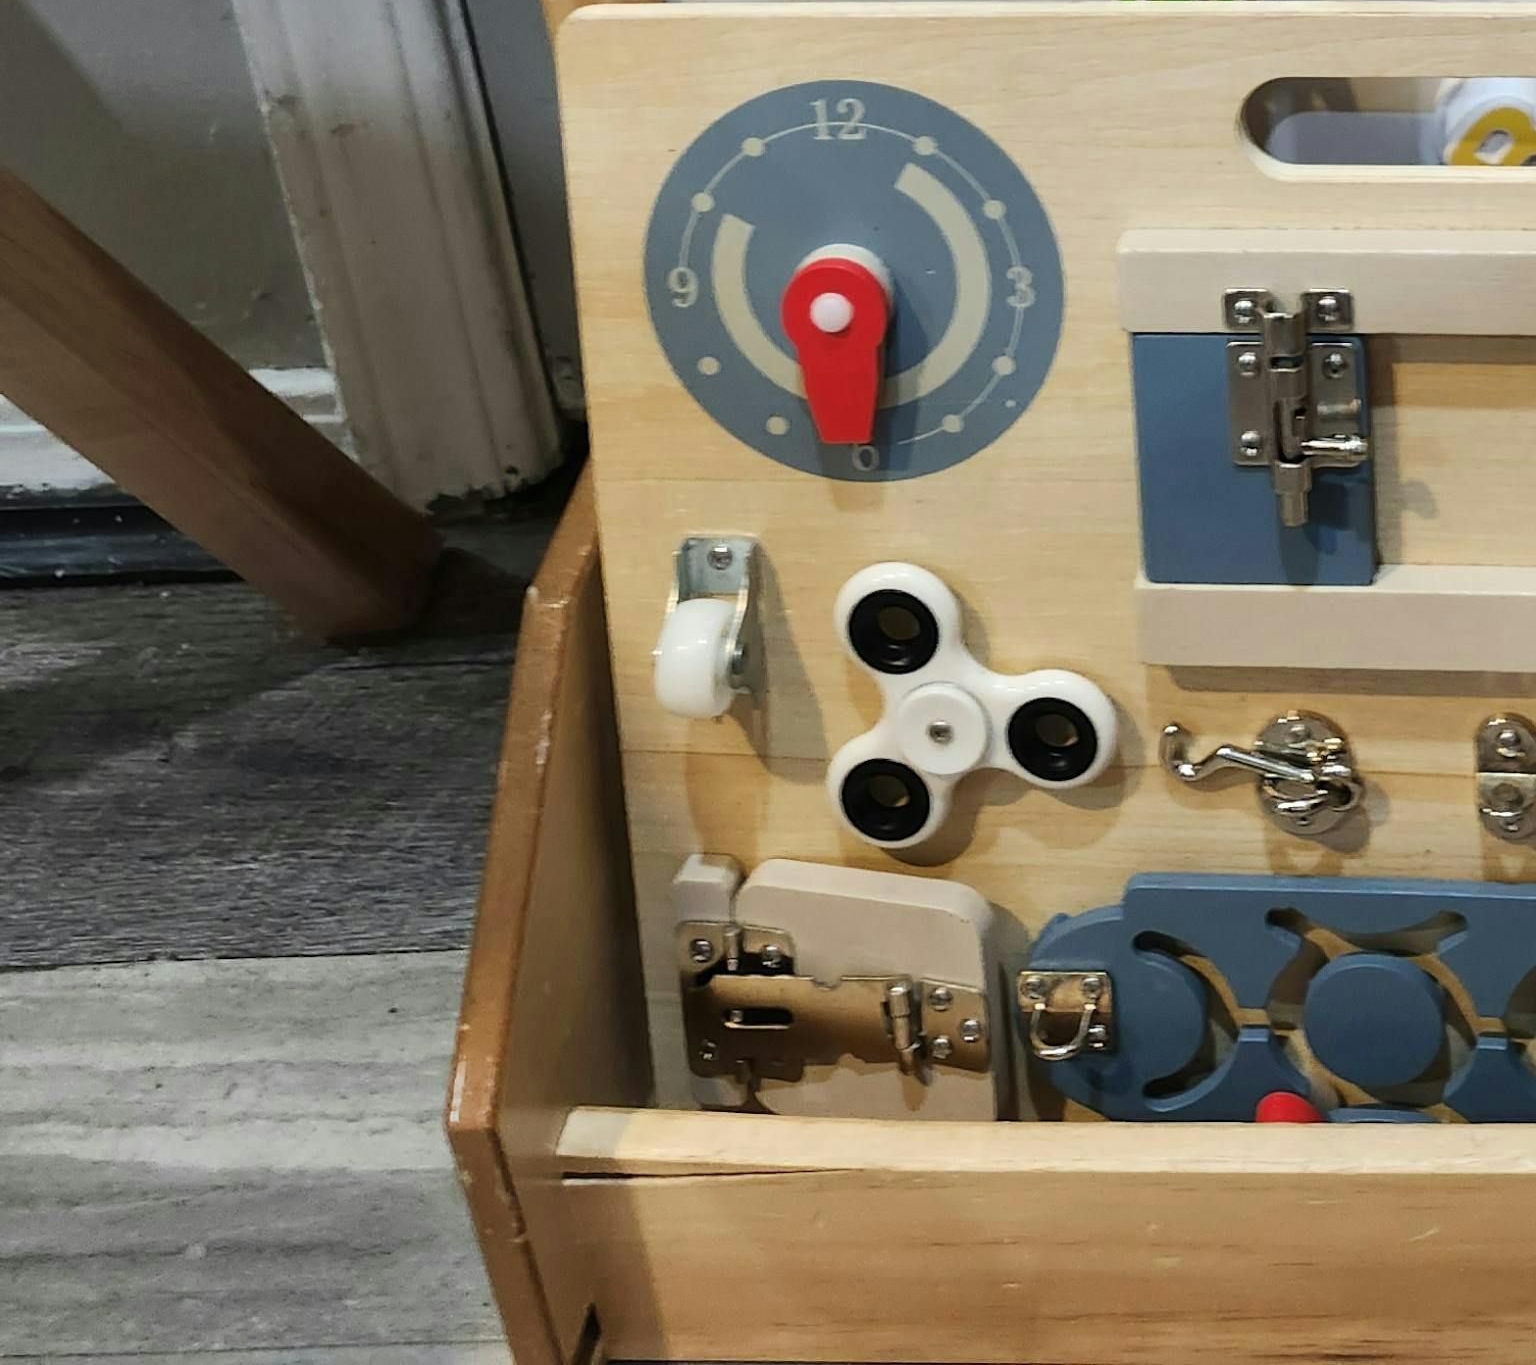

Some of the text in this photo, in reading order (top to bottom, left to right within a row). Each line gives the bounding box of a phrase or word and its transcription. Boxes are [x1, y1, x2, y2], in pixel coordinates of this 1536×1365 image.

[808, 98, 868, 141] 12
[668, 266, 699, 308] 9
[1006, 266, 1036, 308] 3
